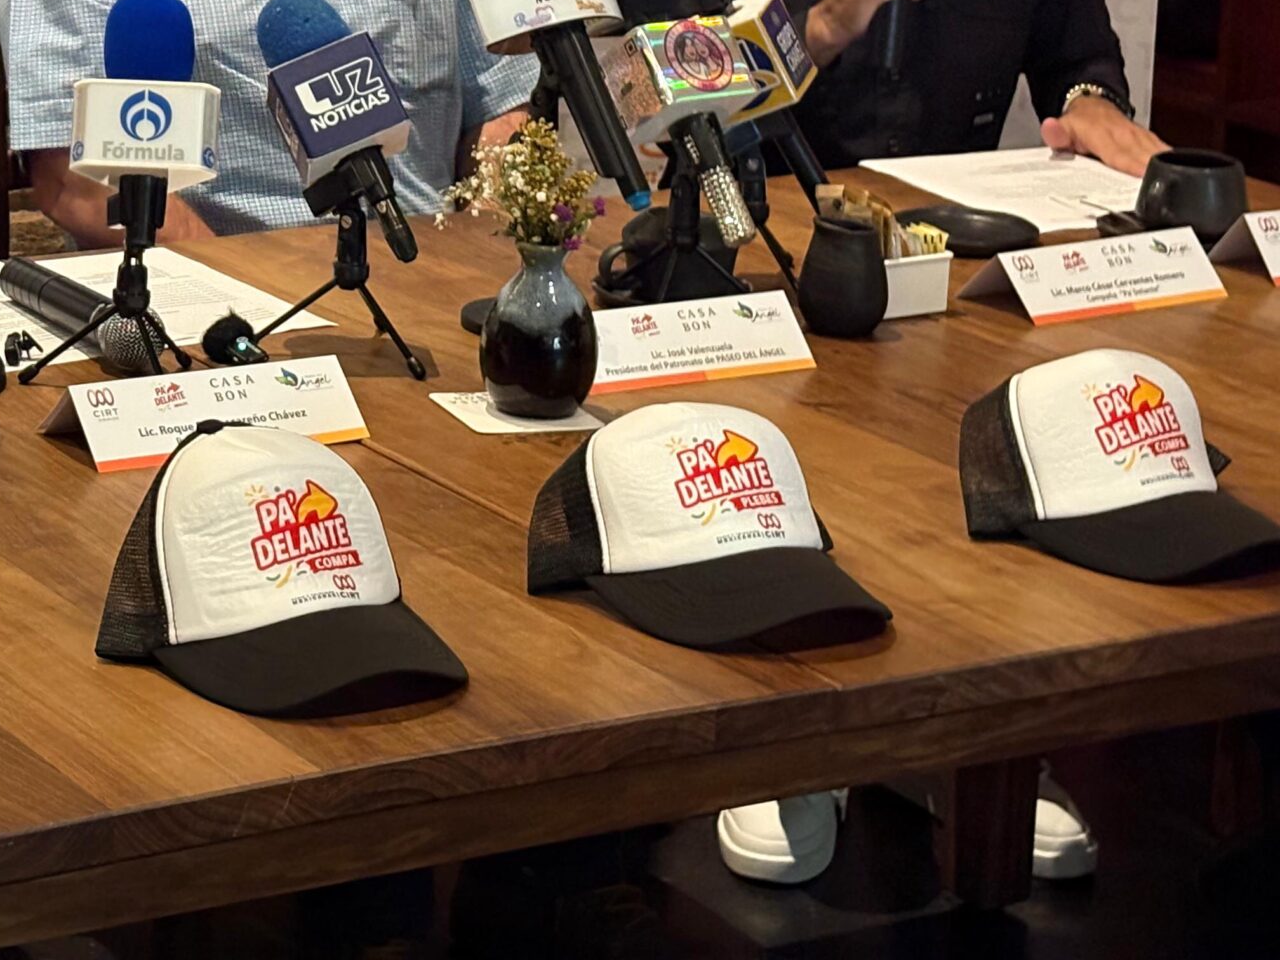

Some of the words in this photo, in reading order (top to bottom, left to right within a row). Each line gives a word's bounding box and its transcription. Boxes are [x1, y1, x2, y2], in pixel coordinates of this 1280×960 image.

[294, 55, 385, 116] LUZ
[309, 88, 391, 133] NOTICIAS
[101, 140, 185, 161] Fórmula
[677, 306, 717, 320] CASA
[682, 320, 712, 333] BON
[605, 363, 649, 376] Presidente
[650, 359, 663, 371] del
[664, 356, 703, 368] Patronato
[705, 354, 715, 364] de
[716, 351, 741, 363] PASEO
[743, 349, 757, 360] DEL
[759, 346, 786, 357] ÁNGEL
[651, 349, 666, 360] Lic.
[667, 346, 686, 358] José
[687, 342, 734, 356] Valenzuela
[209, 373, 255, 388] CASA
[214, 389, 248, 403] BON
[1094, 386, 1127, 423] PA'
[93, 407, 118, 418] CIRT
[138, 426, 159, 438] Lic.
[159, 423, 195, 438] Roque
[268, 409, 308, 421] Chávez
[1096, 403, 1180, 454] DELANTE
[678, 440, 714, 477] PA'
[676, 459, 773, 508] DELANTE
[257, 490, 296, 533] PA'
[741, 493, 779, 507] PLEBES
[252, 515, 351, 570] DELANTE
[315, 552, 356, 569] COMPA
